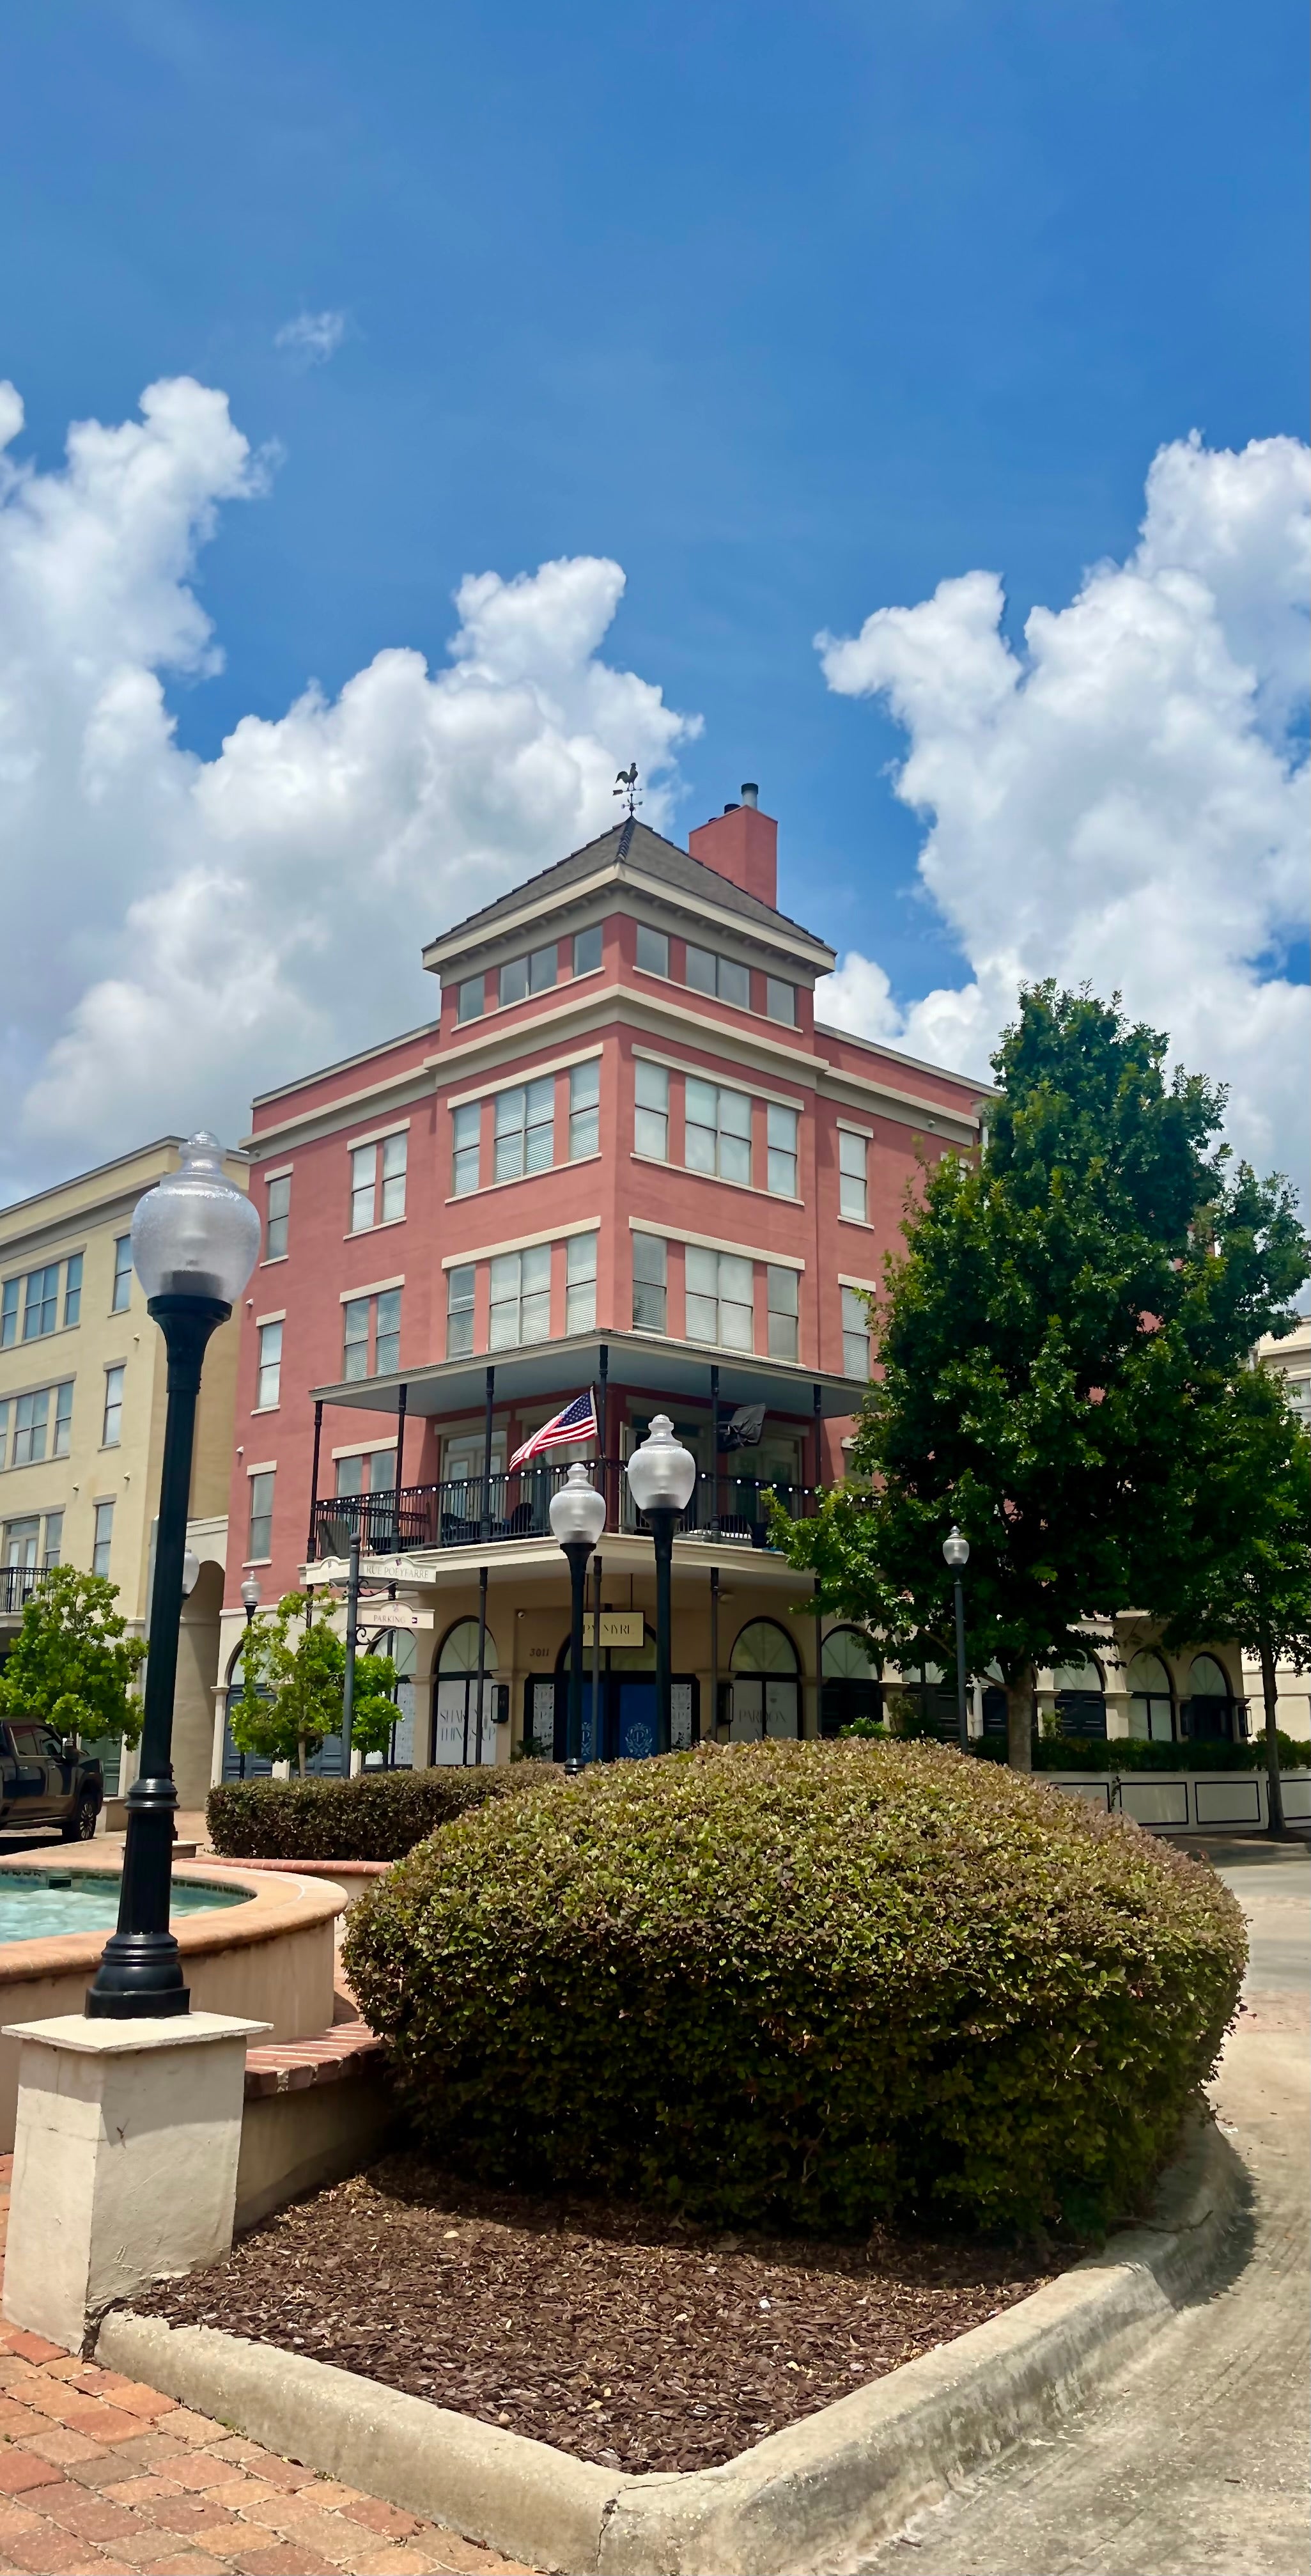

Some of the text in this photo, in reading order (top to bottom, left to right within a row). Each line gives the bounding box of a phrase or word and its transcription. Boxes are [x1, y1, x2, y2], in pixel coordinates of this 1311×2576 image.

[366, 1565, 428, 1579] RUE POEYFARRE
[373, 1614, 406, 1623] PARKING
[529, 1648, 550, 1657] 3011
[582, 1731, 590, 1742] P
[636, 1731, 644, 1742] P
